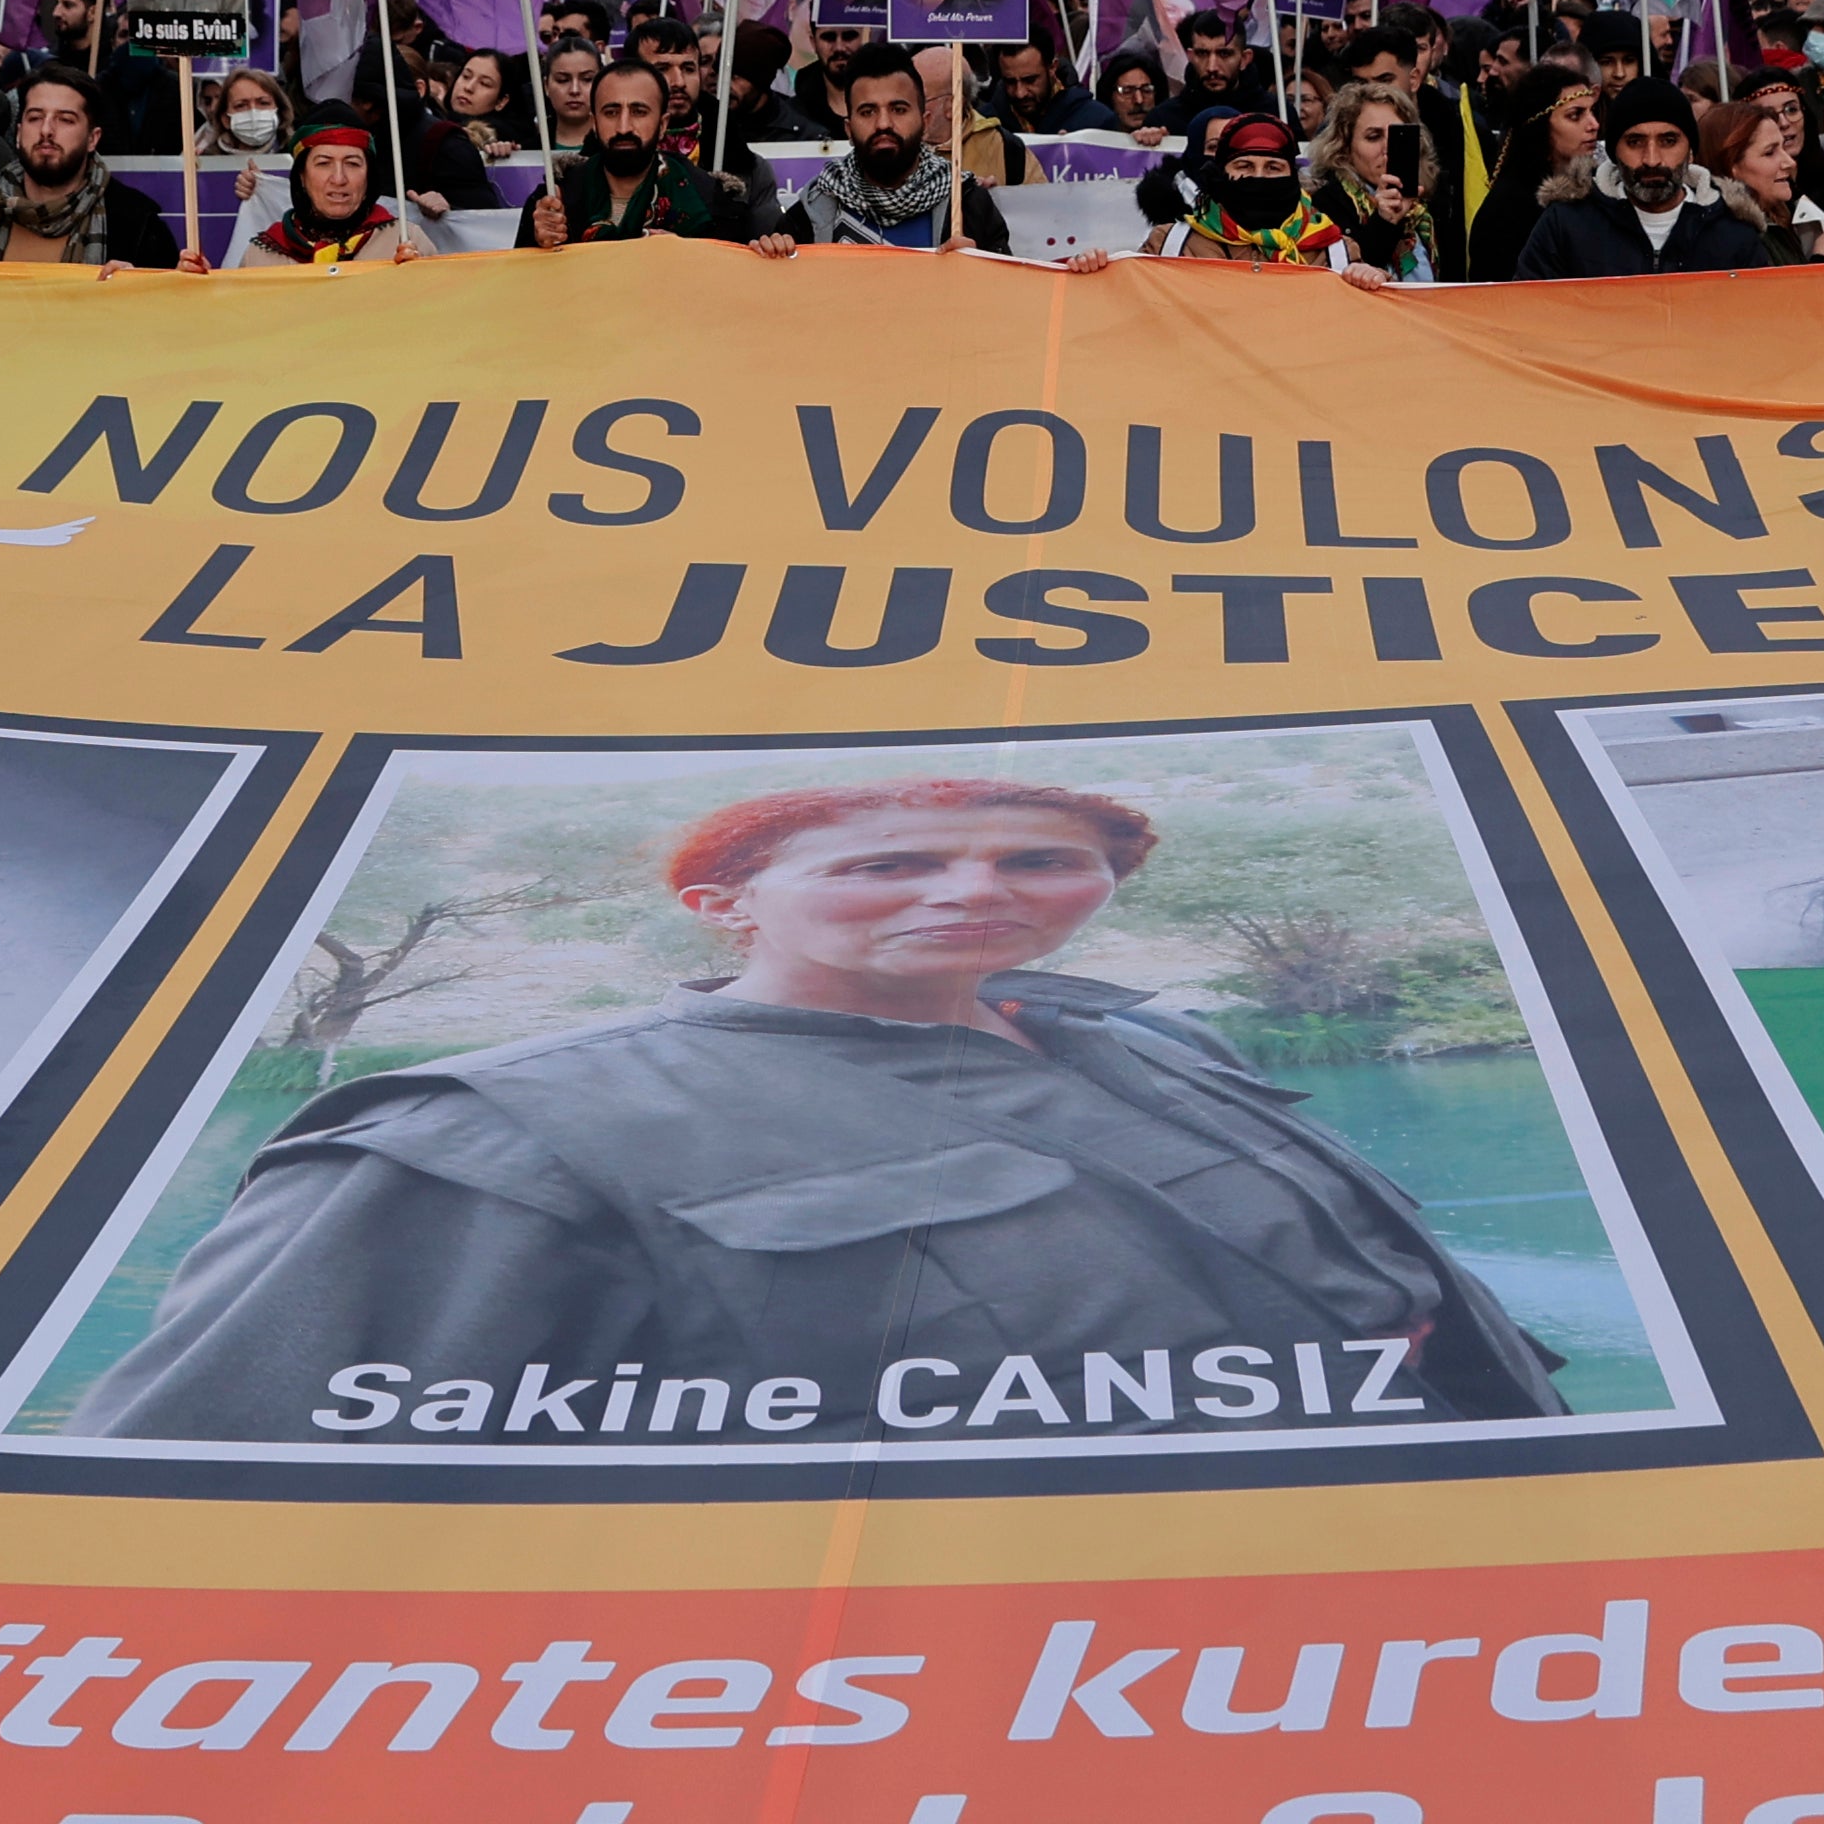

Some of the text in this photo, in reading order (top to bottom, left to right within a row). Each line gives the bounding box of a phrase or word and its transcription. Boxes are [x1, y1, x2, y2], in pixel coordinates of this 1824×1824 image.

[135, 17, 238, 41] Je suis Evîn!
[14, 393, 704, 530] NOUS
[137, 542, 468, 662] LA
[310, 1336, 1427, 1435] Sakine CANSIZ
